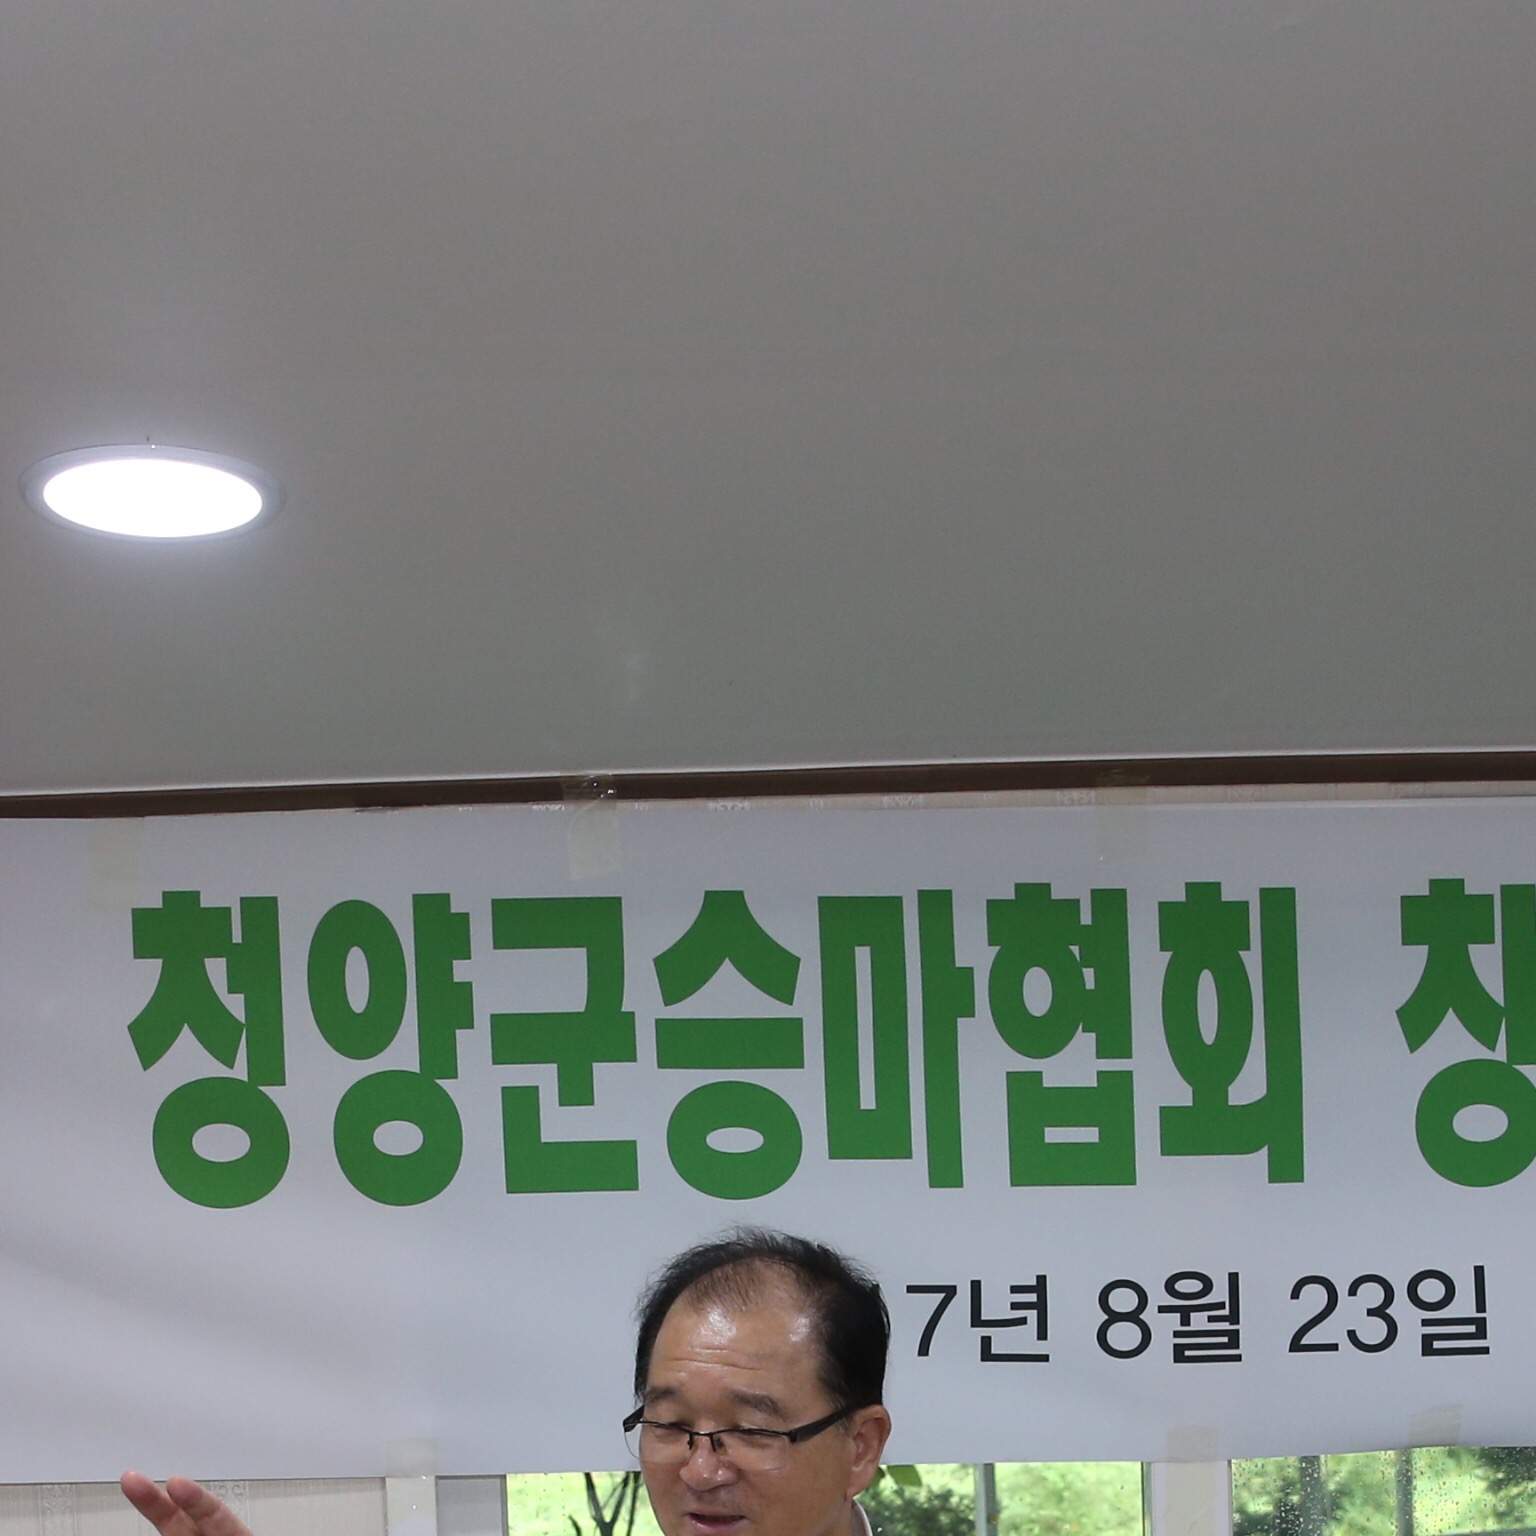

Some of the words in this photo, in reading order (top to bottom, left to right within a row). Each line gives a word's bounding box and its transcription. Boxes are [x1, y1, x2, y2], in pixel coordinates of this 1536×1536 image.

[129, 882, 1304, 1209] 청양군승마협회
[906, 1274, 1050, 1364] 7년
[1096, 1271, 1243, 1364] 8월
[1288, 1265, 1491, 1357] 23일
